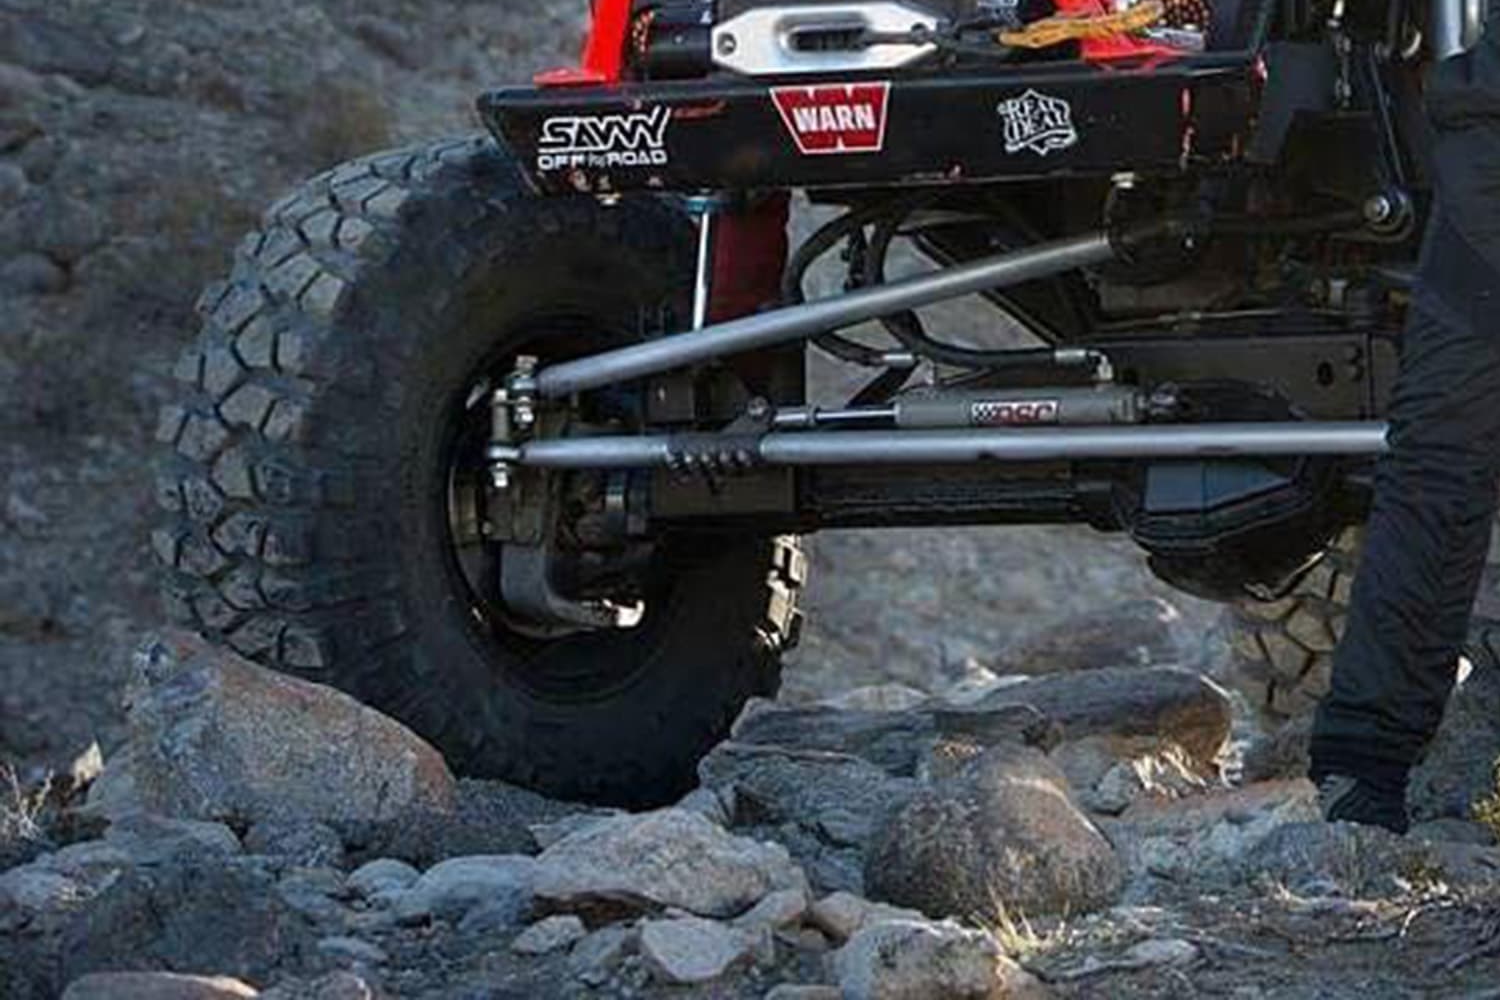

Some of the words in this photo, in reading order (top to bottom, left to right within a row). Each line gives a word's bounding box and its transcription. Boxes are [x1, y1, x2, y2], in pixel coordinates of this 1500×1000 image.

[538, 105, 671, 153] SAVVY
[795, 101, 877, 132] WARN
[537, 154, 585, 171] OFF
[607, 150, 668, 168] ROAD
